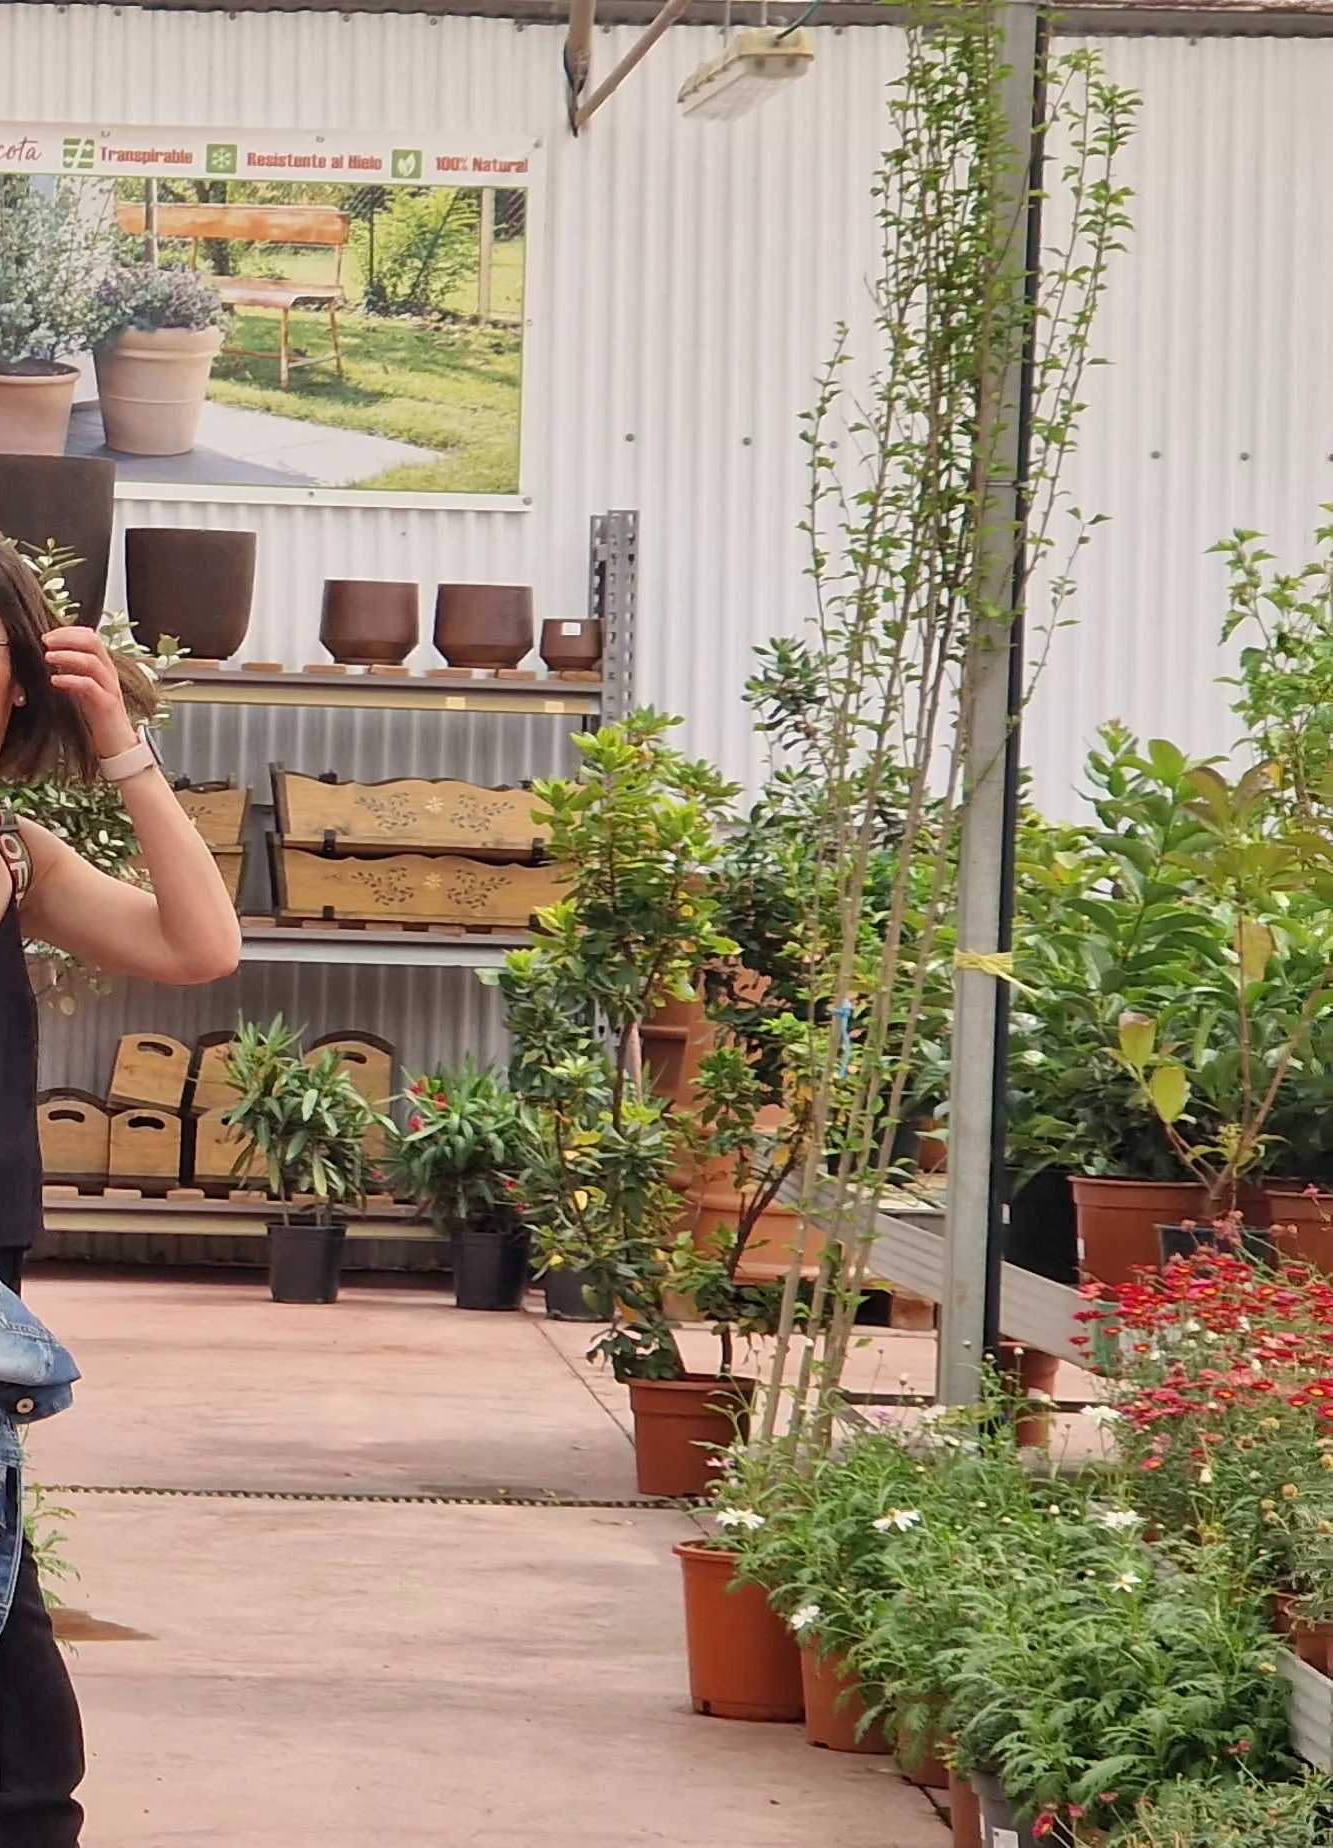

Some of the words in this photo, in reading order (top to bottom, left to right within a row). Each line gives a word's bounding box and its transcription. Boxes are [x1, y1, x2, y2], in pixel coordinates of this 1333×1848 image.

[100, 146, 193, 165] Transpirable
[247, 152, 326, 169] Resistente
[331, 154, 344, 169] al
[348, 154, 383, 171] Hielo
[436, 156, 468, 172] 100%
[472, 157, 528, 174] Natural
